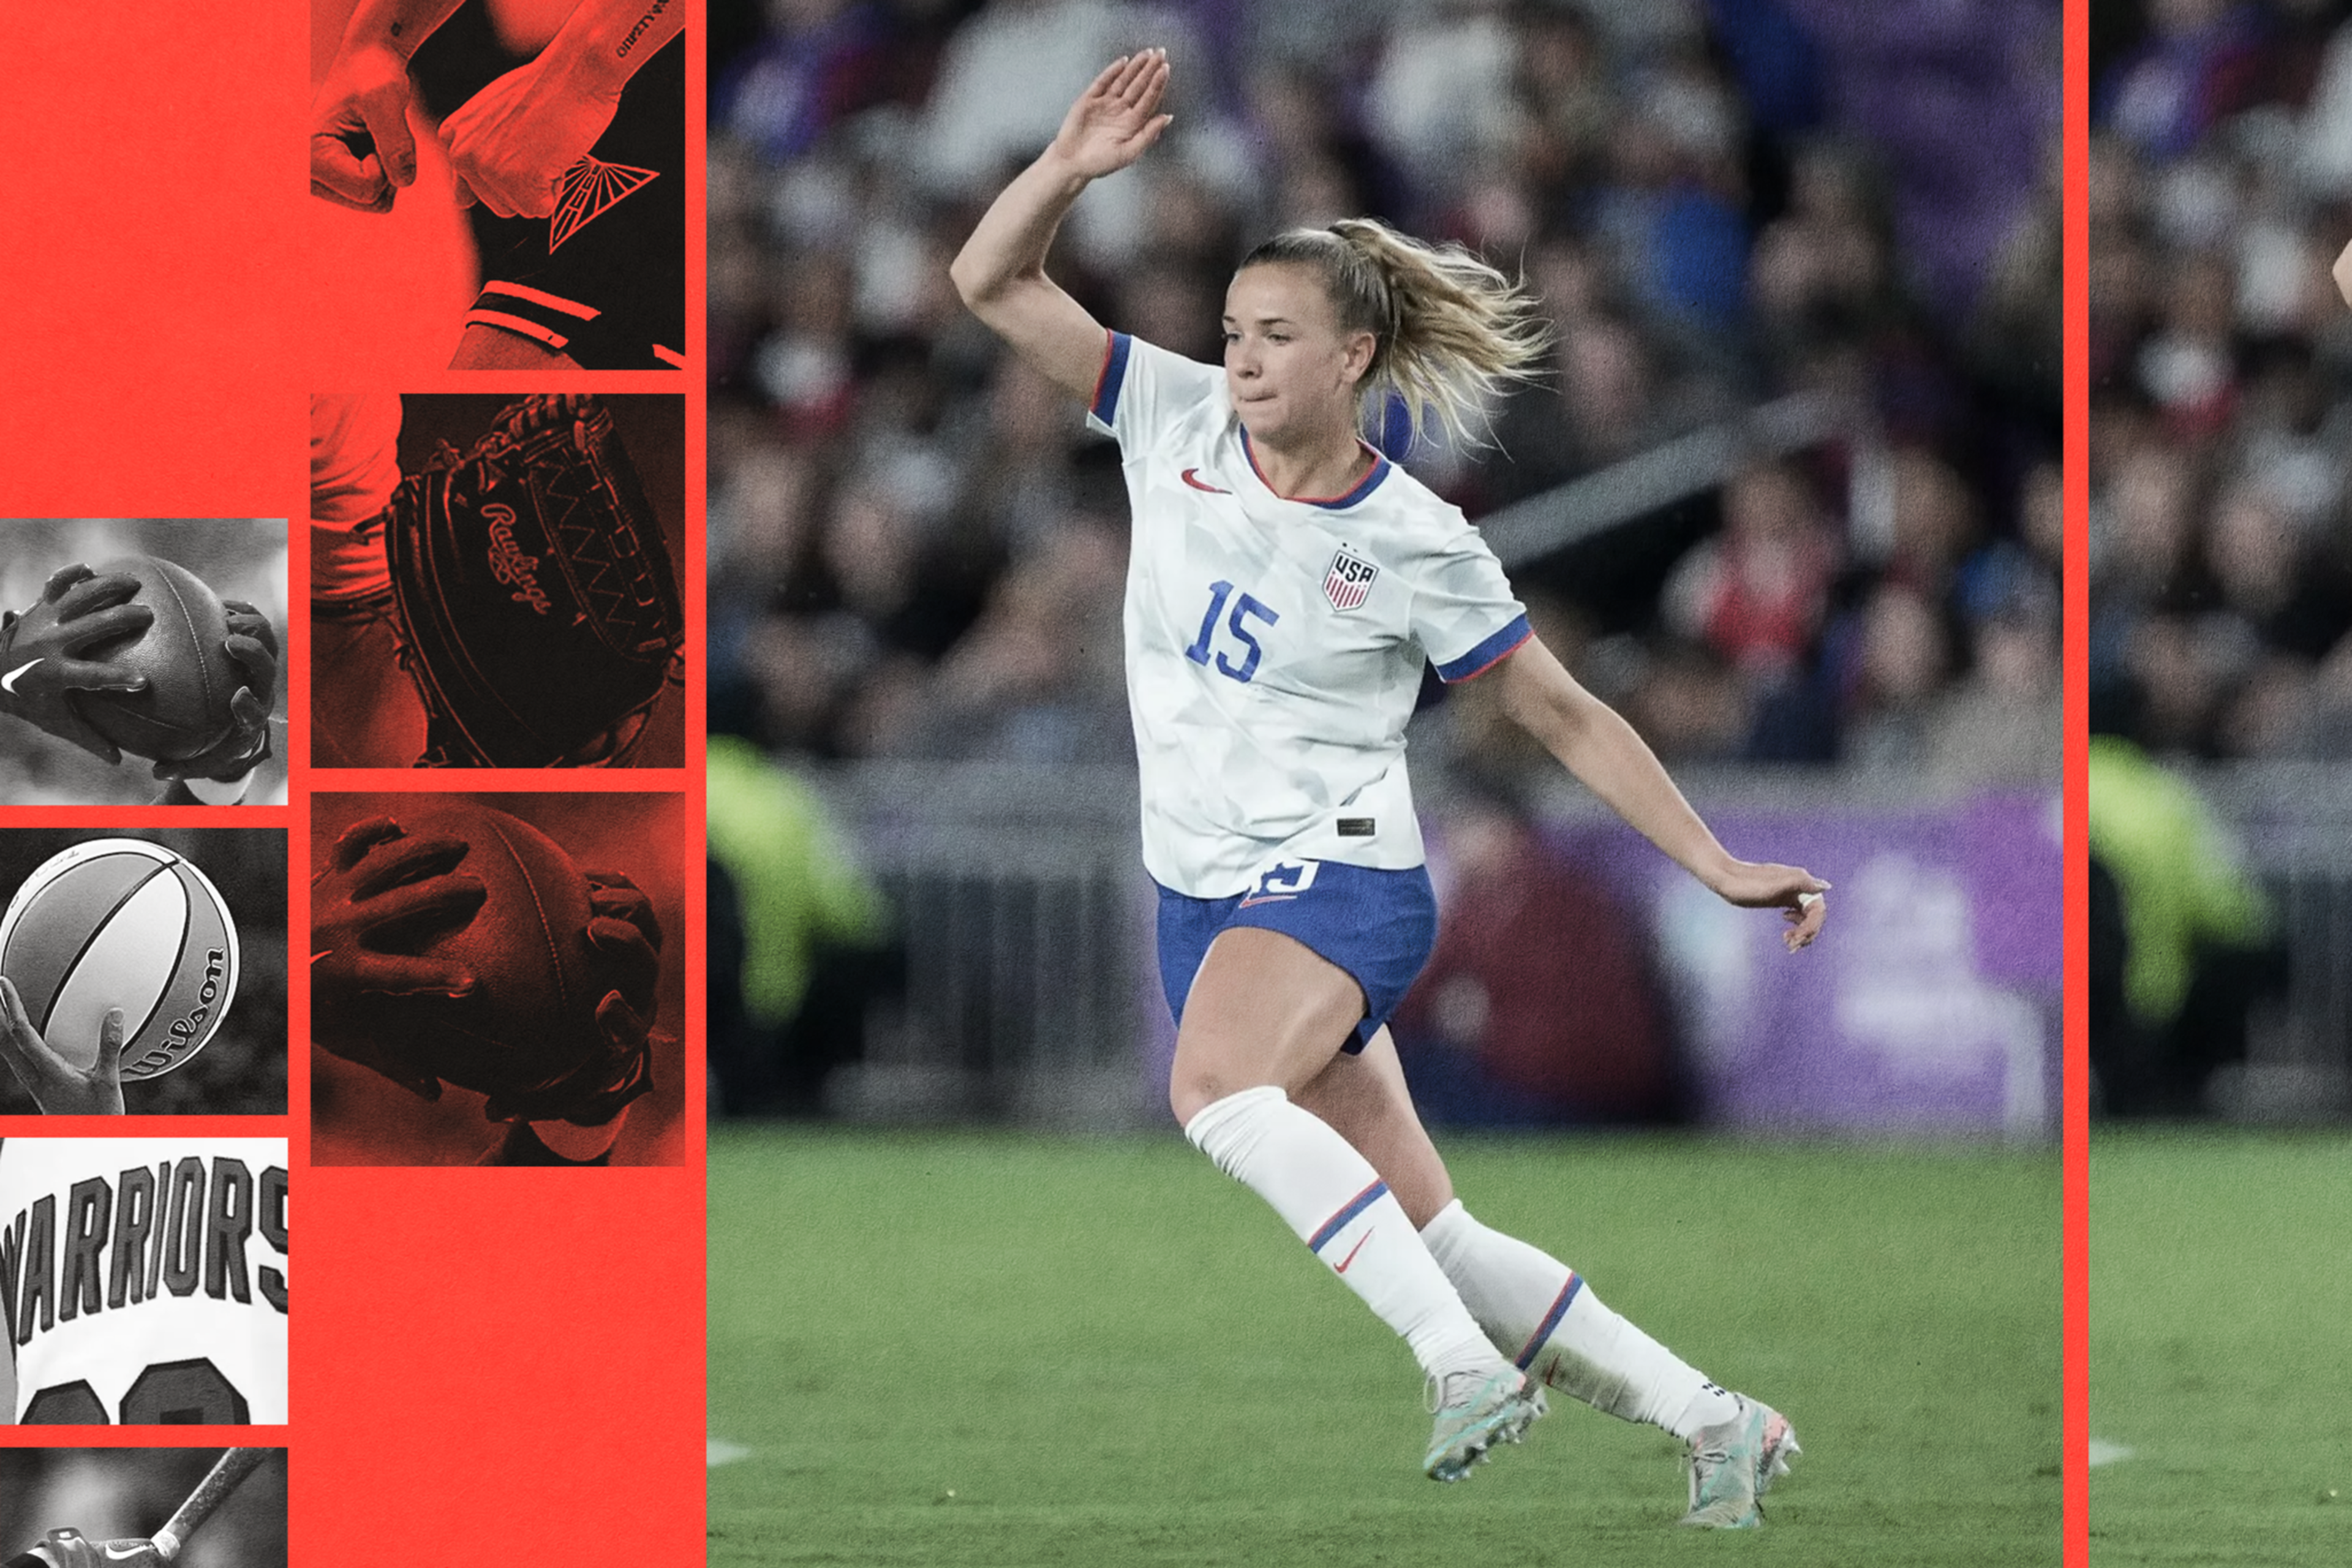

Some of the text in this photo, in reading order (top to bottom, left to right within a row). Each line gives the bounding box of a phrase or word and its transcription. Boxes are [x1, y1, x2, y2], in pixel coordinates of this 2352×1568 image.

[481, 503, 552, 616] Rawlings
[1335, 555, 1374, 583] USA
[1185, 579, 1280, 683] 15
[121, 947, 224, 1074] Wilson
